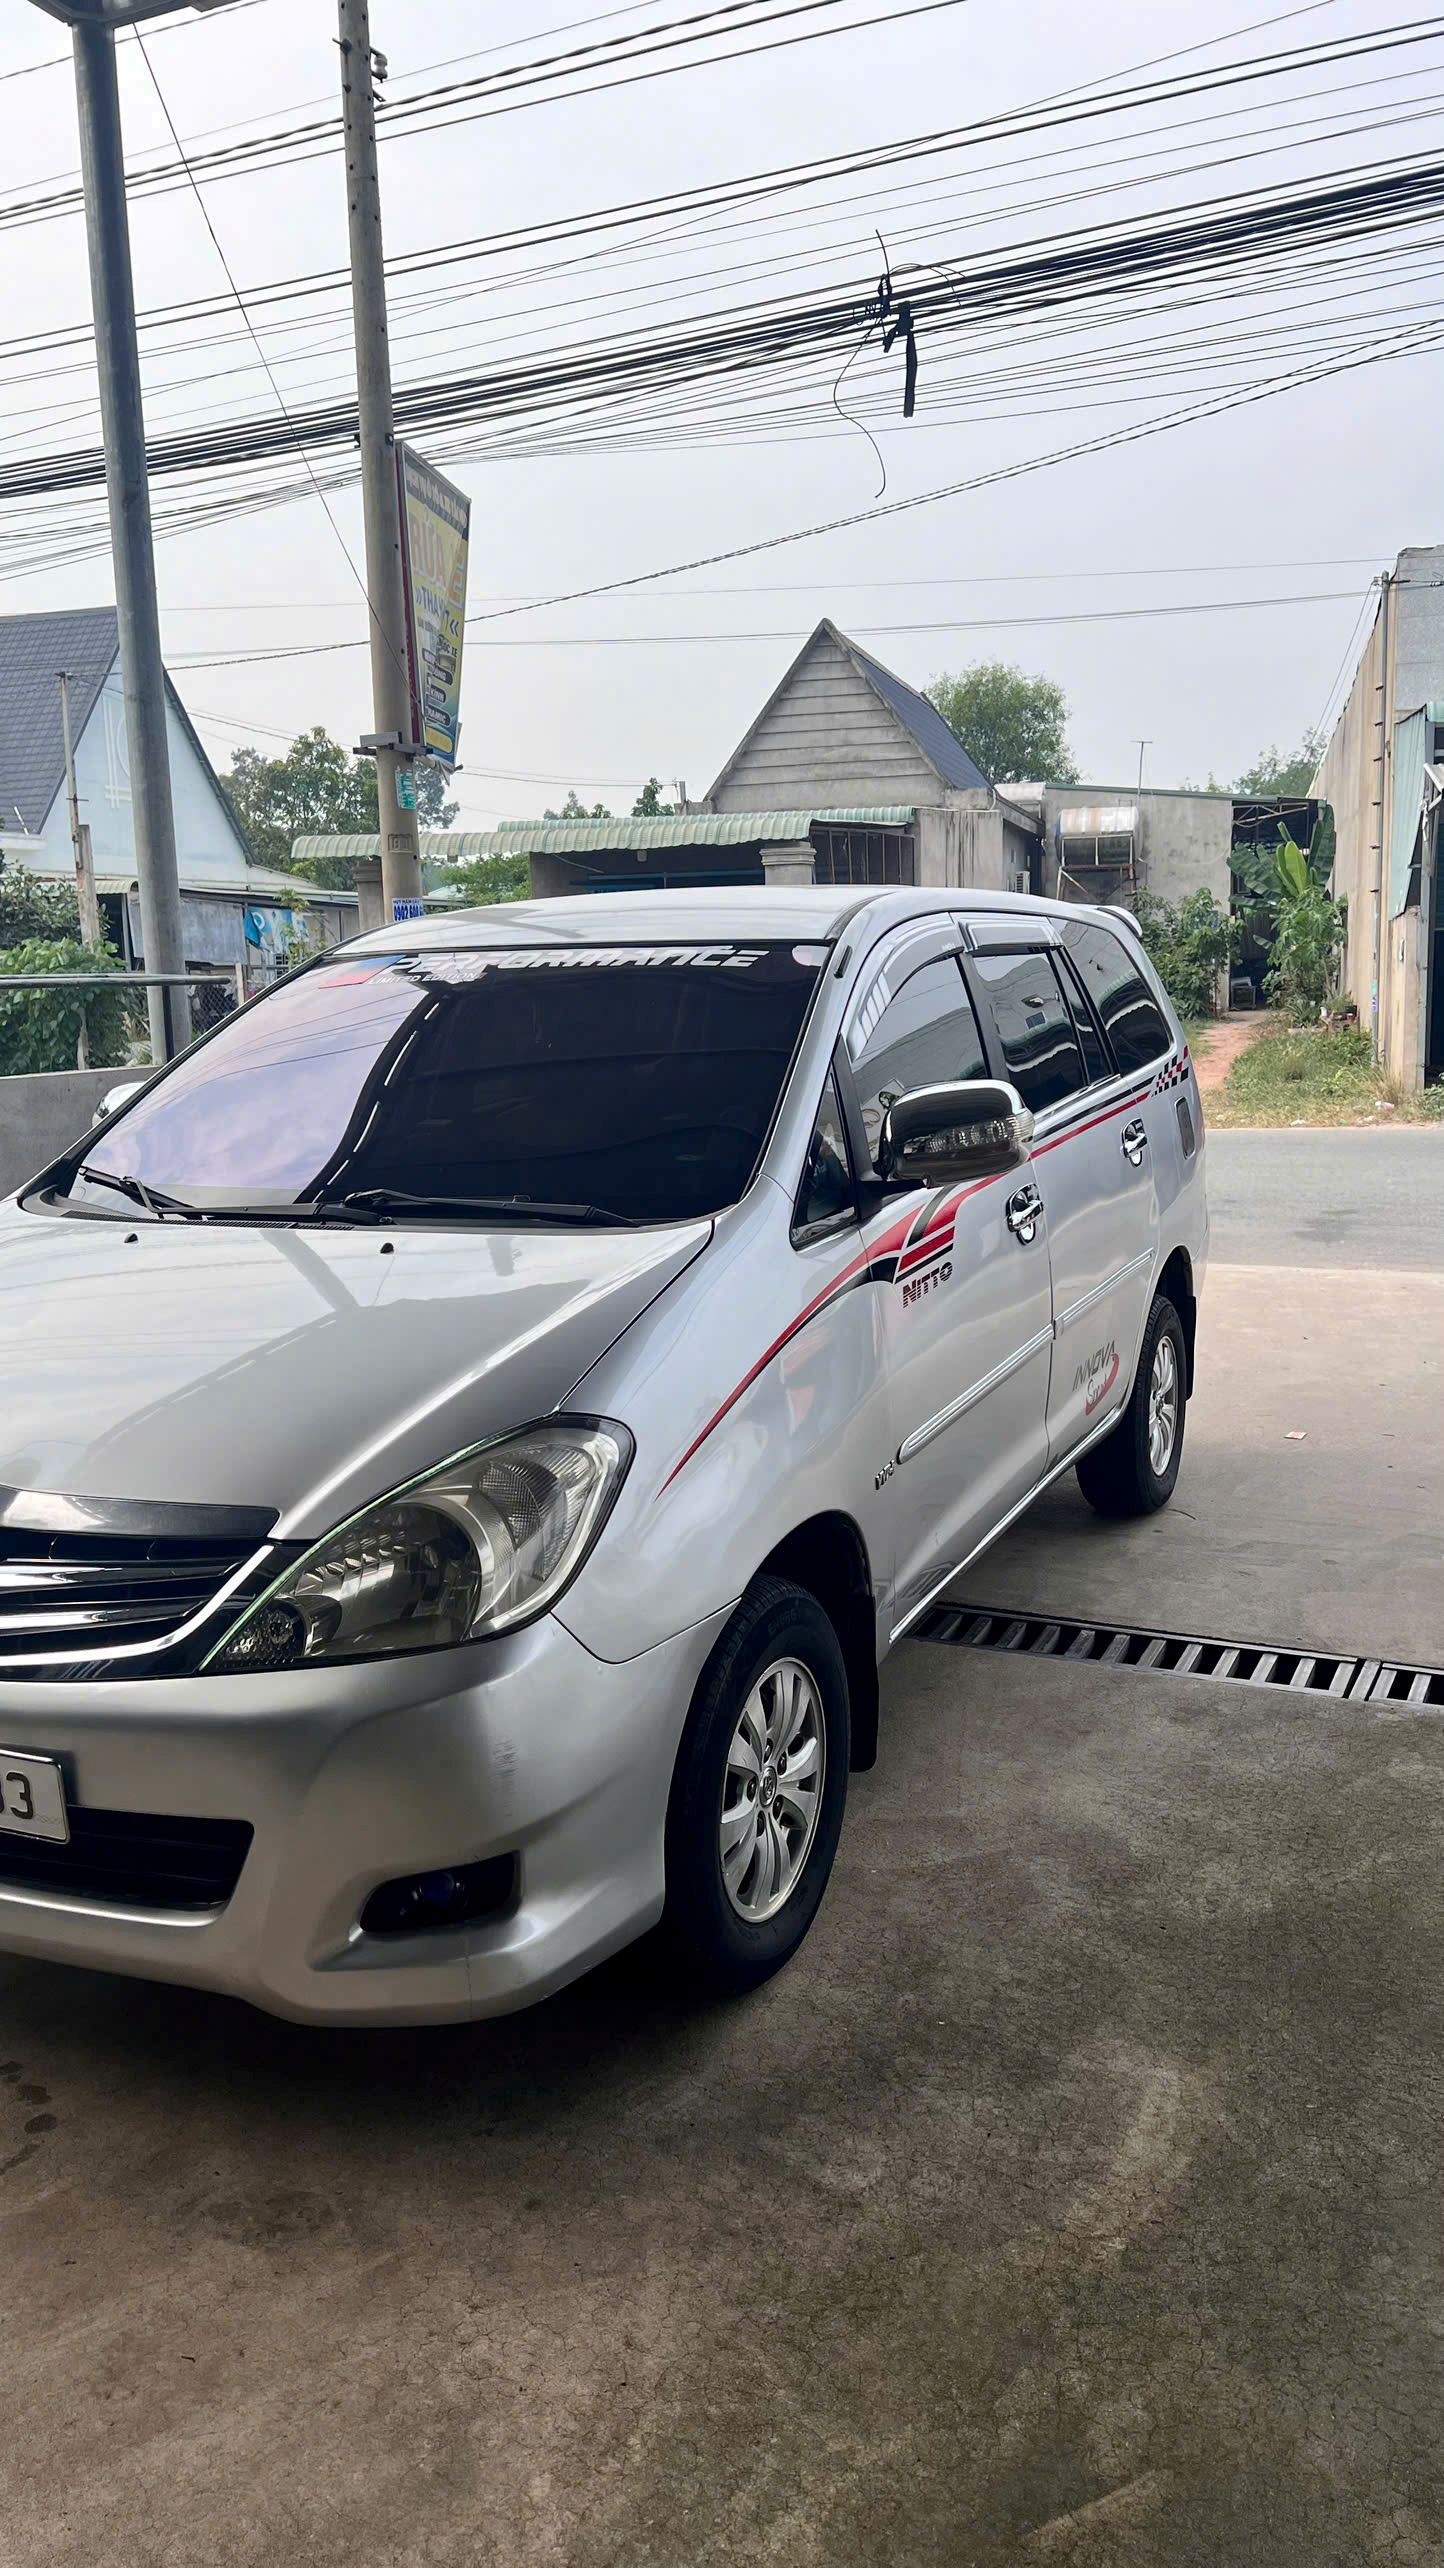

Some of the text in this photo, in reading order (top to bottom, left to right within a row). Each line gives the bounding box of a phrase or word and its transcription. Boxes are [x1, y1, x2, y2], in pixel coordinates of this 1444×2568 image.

[396, 945, 769, 973] PERFORMANCE
[370, 972, 476, 984] LIMITED EDITION
[903, 1262, 953, 1308] NITTO
[1072, 1340, 1115, 1392] INNOVA
